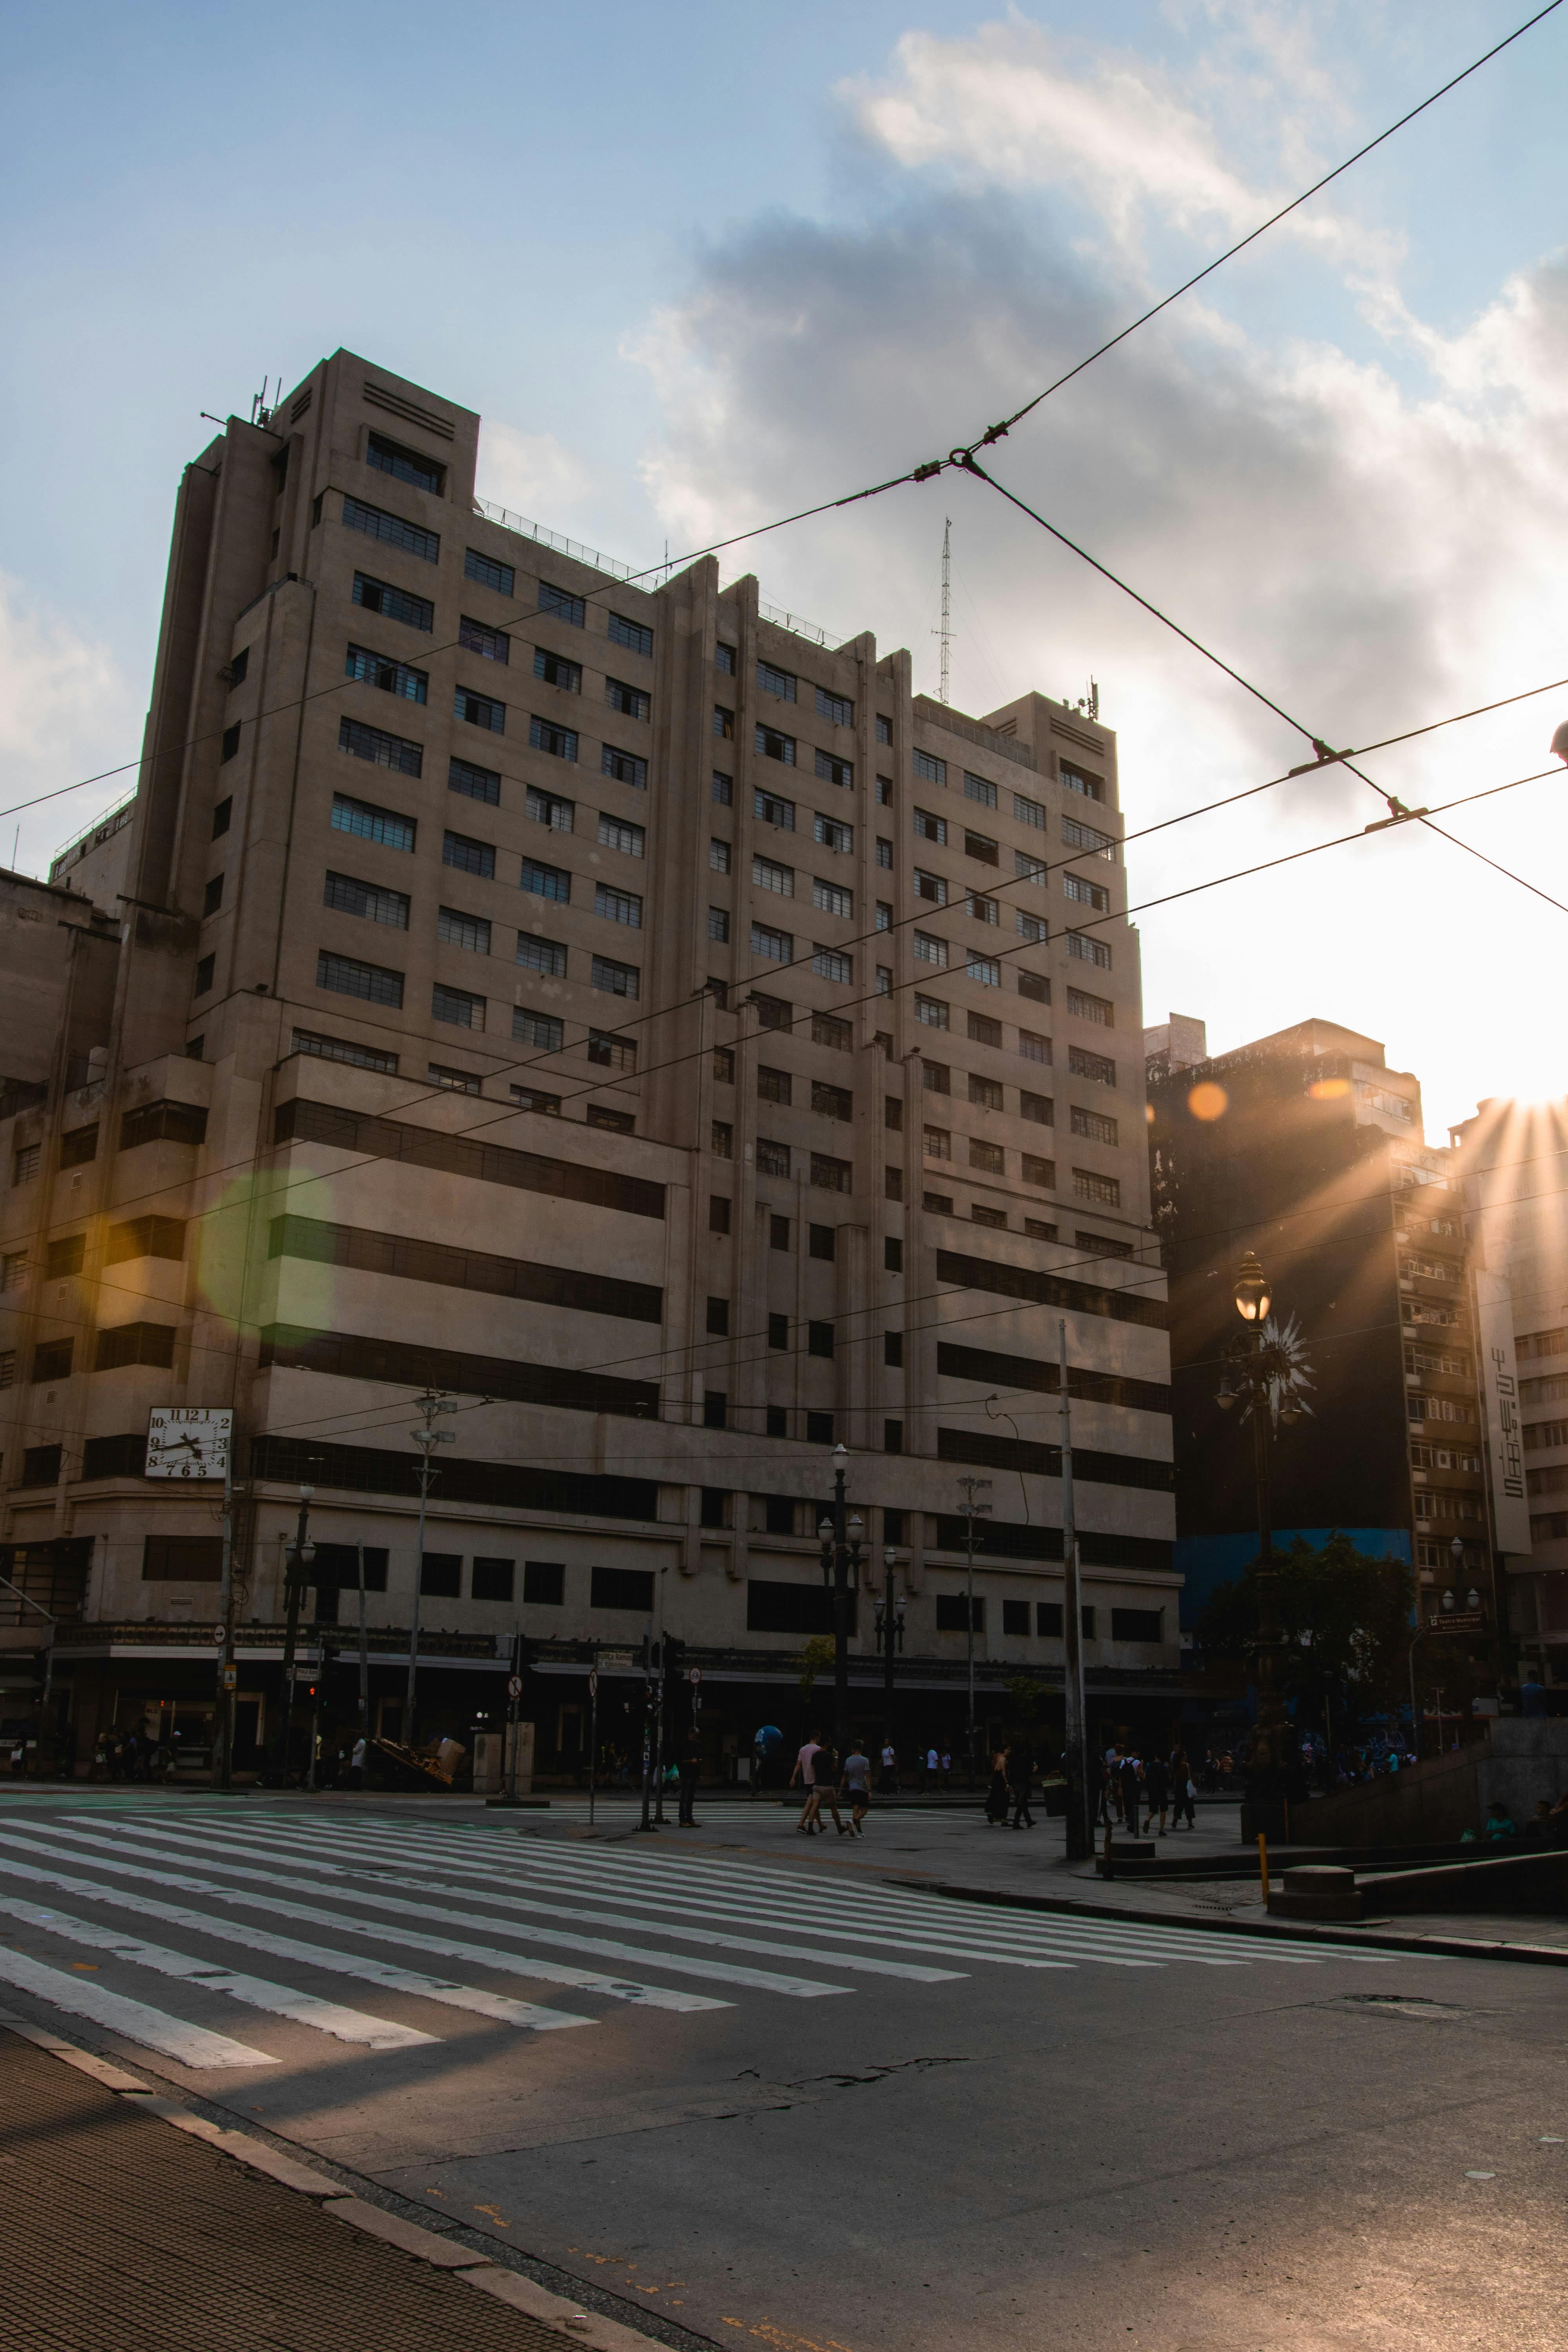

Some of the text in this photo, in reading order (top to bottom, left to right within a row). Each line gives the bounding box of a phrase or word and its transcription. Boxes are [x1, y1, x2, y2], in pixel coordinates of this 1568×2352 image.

[170, 1410, 180, 1420] 11
[185, 1410, 199, 1421] 12
[205, 1410, 210, 1421] 1
[151, 1417, 164, 1428] 10
[220, 1418, 230, 1429] 2
[151, 1437, 160, 1449] 9
[218, 1438, 227, 1449] 3
[148, 1456, 158, 1467] 8
[217, 1457, 226, 1467] 4
[167, 1465, 176, 1476] 7
[181, 1465, 191, 1477] 6
[198, 1466, 207, 1477] 5
